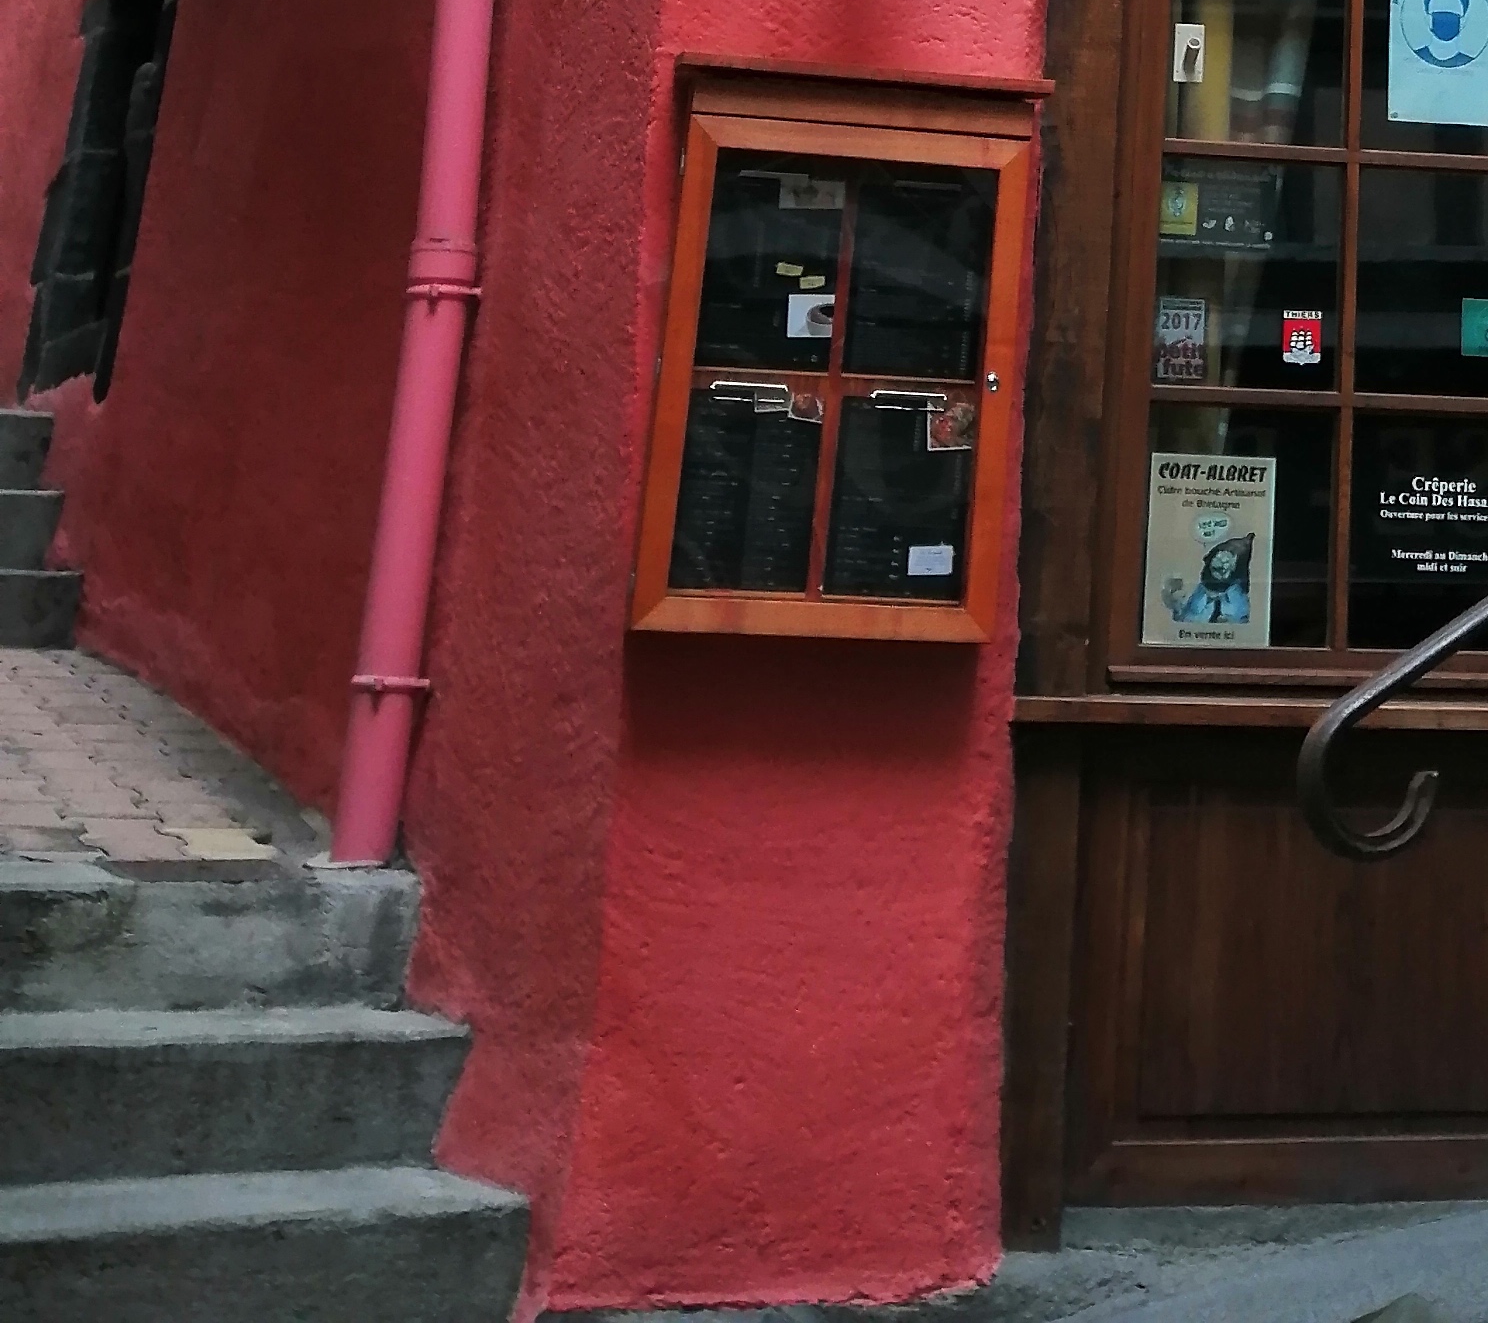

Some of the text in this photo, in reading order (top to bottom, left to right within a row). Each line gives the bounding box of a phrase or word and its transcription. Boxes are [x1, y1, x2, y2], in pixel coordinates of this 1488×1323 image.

[1160, 312, 1202, 331] 2017
[1158, 461, 1267, 483] COAT-ALBRET
[1411, 476, 1477, 495] Crêperie
[1380, 491, 1396, 504] Le
[1398, 492, 1428, 506] Coin
[1431, 494, 1454, 506] Des
[1380, 509, 1424, 519] Ouverture
[1425, 511, 1445, 522] pour
[1391, 549, 1433, 560] Mercredi
[1417, 562, 1438, 572] midi
